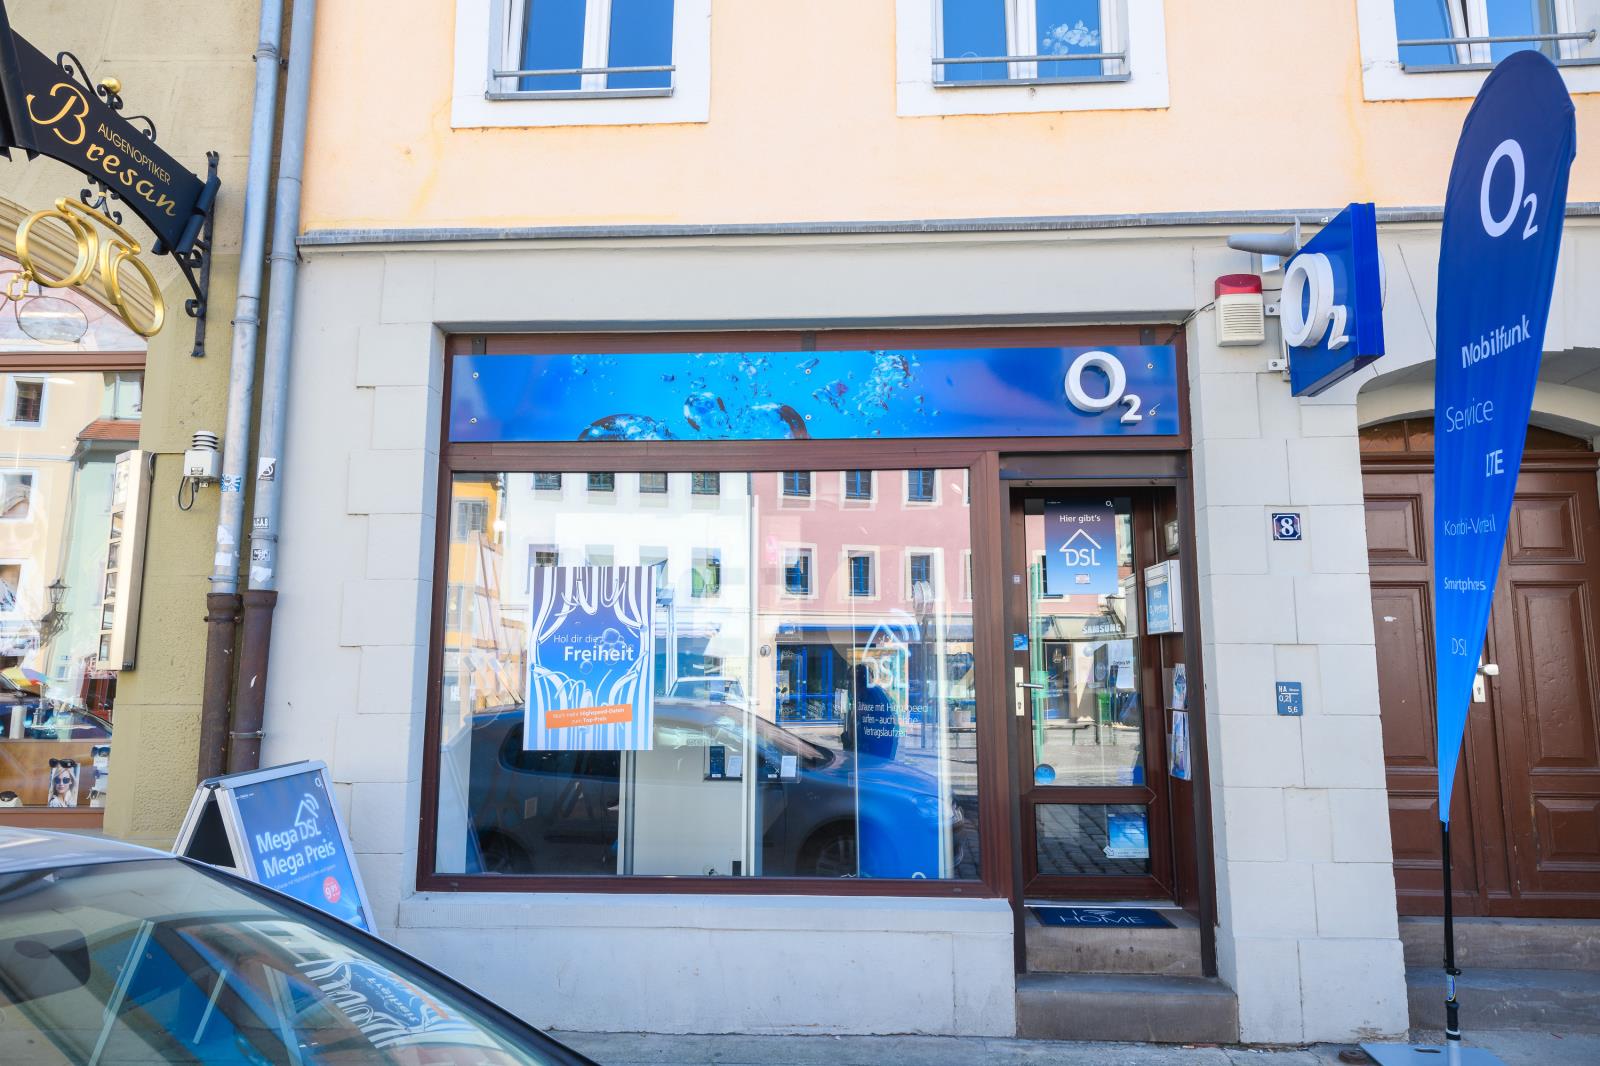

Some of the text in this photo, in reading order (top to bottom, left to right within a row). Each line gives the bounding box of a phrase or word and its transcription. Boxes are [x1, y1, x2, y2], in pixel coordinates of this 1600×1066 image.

[26, 82, 177, 217] Bresan
[98, 122, 172, 186] AUGENOPTIKER
[1461, 314, 1531, 369] Mobilfunk
[1485, 449, 1504, 477] LTE
[1059, 513, 1101, 524] Hier gibt's
[1281, 517, 1294, 537] 8
[1065, 548, 1101, 567] DSL
[553, 634, 569, 643] Hol
[571, 634, 583, 643] dir
[1082, 623, 1122, 634] SAMSUNG
[564, 645, 634, 662] Freiheit
[256, 817, 322, 854] Mega DSL
[262, 852, 305, 880] Mega
[306, 838, 336, 863] Preis
[1059, 915, 1145, 924] HOME
